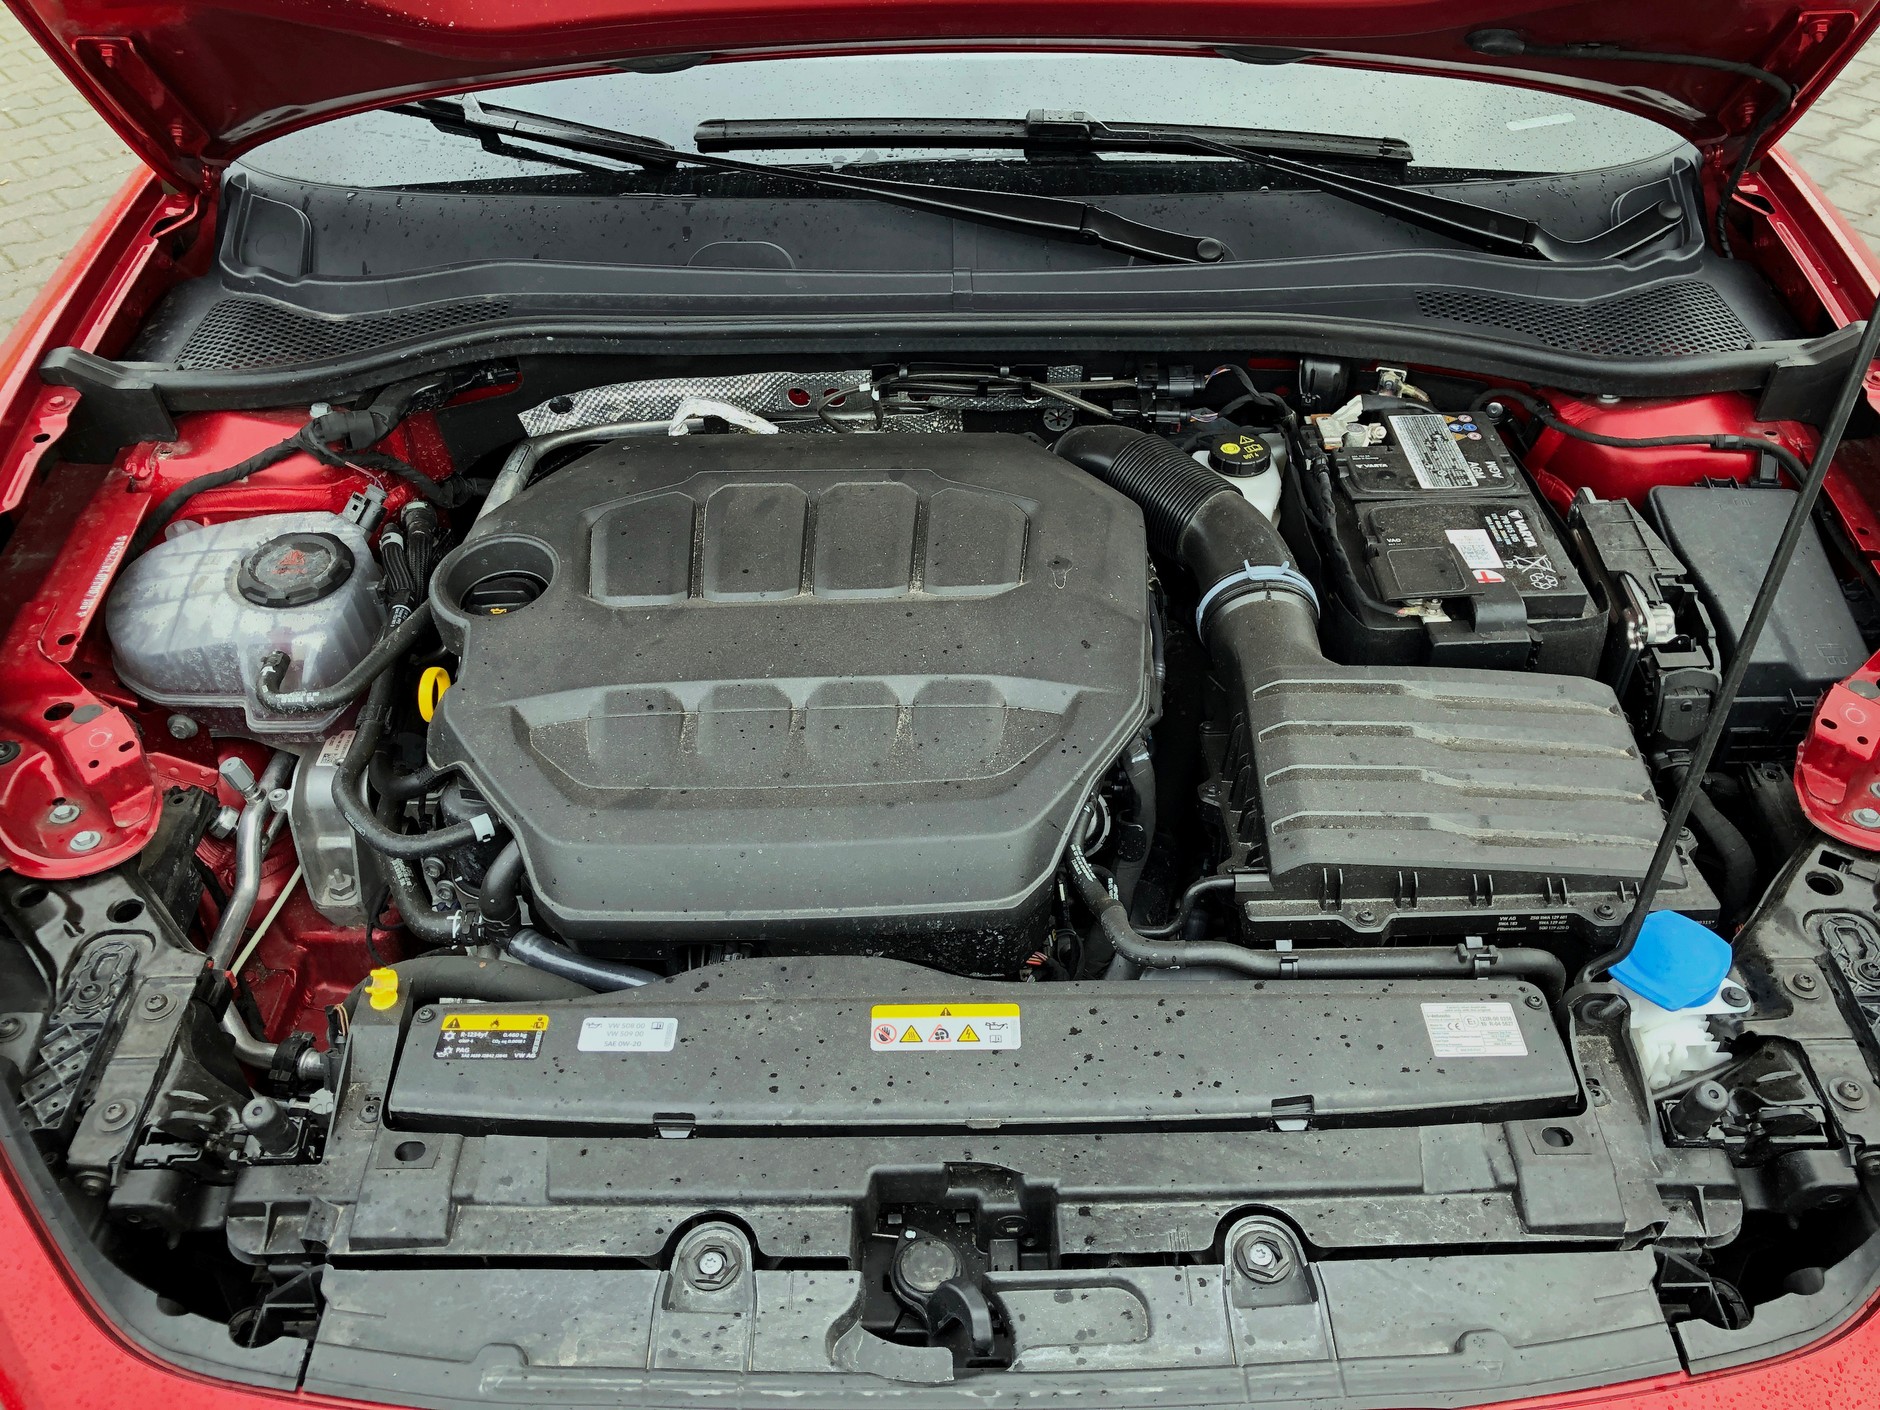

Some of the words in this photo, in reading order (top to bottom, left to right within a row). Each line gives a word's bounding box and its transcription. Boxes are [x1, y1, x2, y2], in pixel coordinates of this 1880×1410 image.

[1467, 461, 1487, 479] AGM
[1484, 461, 1505, 479] AGM
[1514, 519, 1538, 548] VARTA
